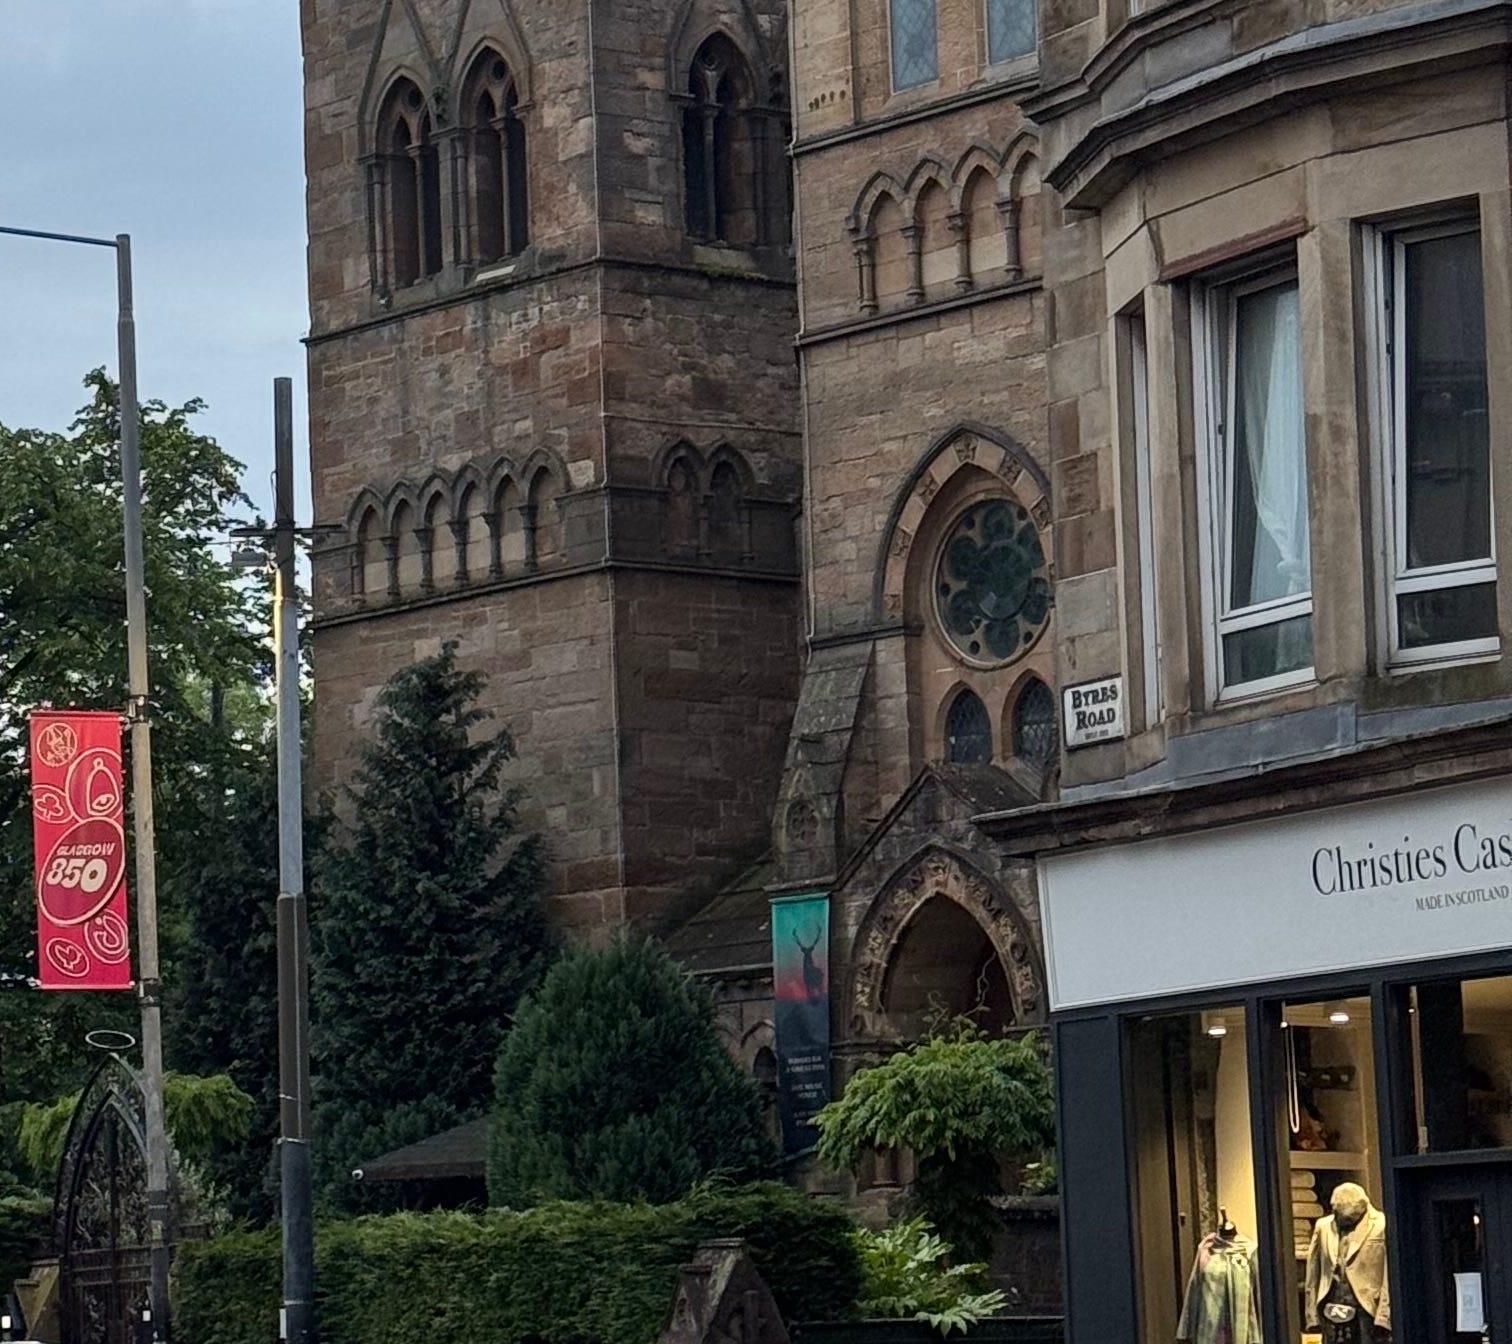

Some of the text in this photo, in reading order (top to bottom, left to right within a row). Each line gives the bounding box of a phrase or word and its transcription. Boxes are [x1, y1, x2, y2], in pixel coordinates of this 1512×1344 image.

[1071, 684, 1118, 709] BYRES
[1075, 708, 1116, 731] ROAD
[56, 842, 116, 856] GLASGOW
[1312, 817, 1512, 895] Christies Cas
[46, 858, 108, 893] 850
[1415, 885, 1510, 911] MADE IN SCOTLAND
